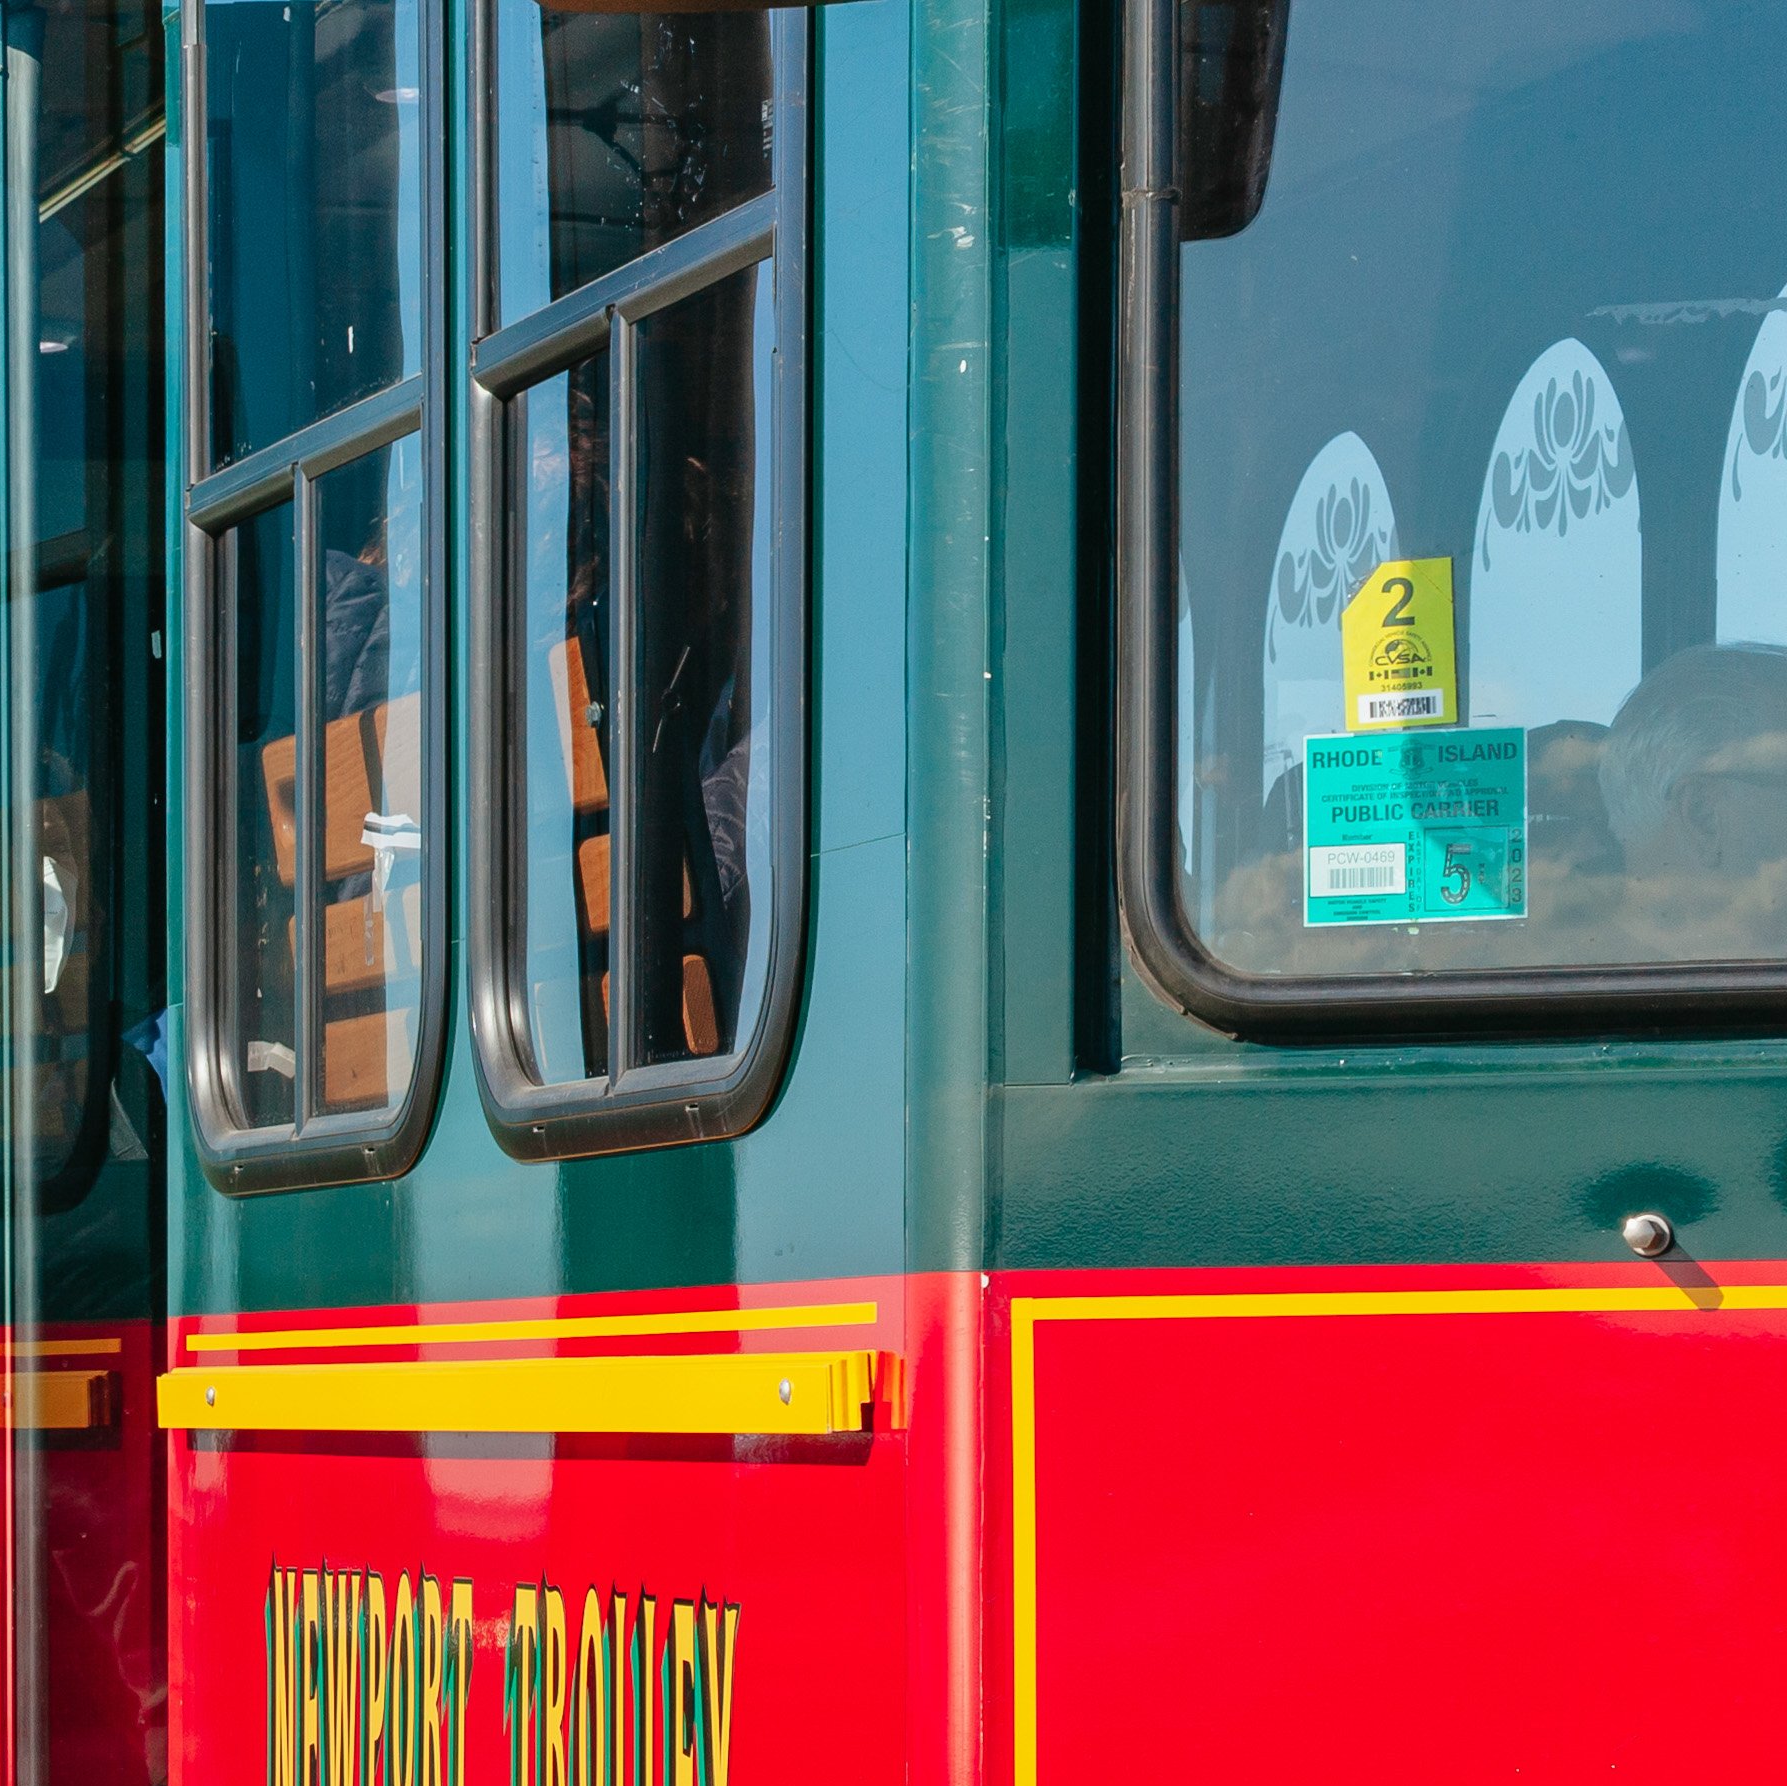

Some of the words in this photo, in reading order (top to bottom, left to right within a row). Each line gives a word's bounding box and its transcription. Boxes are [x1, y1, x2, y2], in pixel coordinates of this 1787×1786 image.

[1382, 577, 1416, 628] 2
[1375, 652, 1426, 666] CVSA
[1313, 748, 1384, 770] RHODE
[1438, 742, 1518, 764] ISLAND
[1321, 793, 1374, 803] CERTIFICATE
[1377, 792, 1388, 801] OF
[1331, 803, 1404, 824] PUBLIC
[1411, 799, 1500, 820] CARRIER
[1327, 850, 1396, 866] PCW-0469
[1407, 831, 1416, 913] EXPIRES
[1511, 828, 1523, 903] 2023
[1441, 843, 1472, 905] 5
